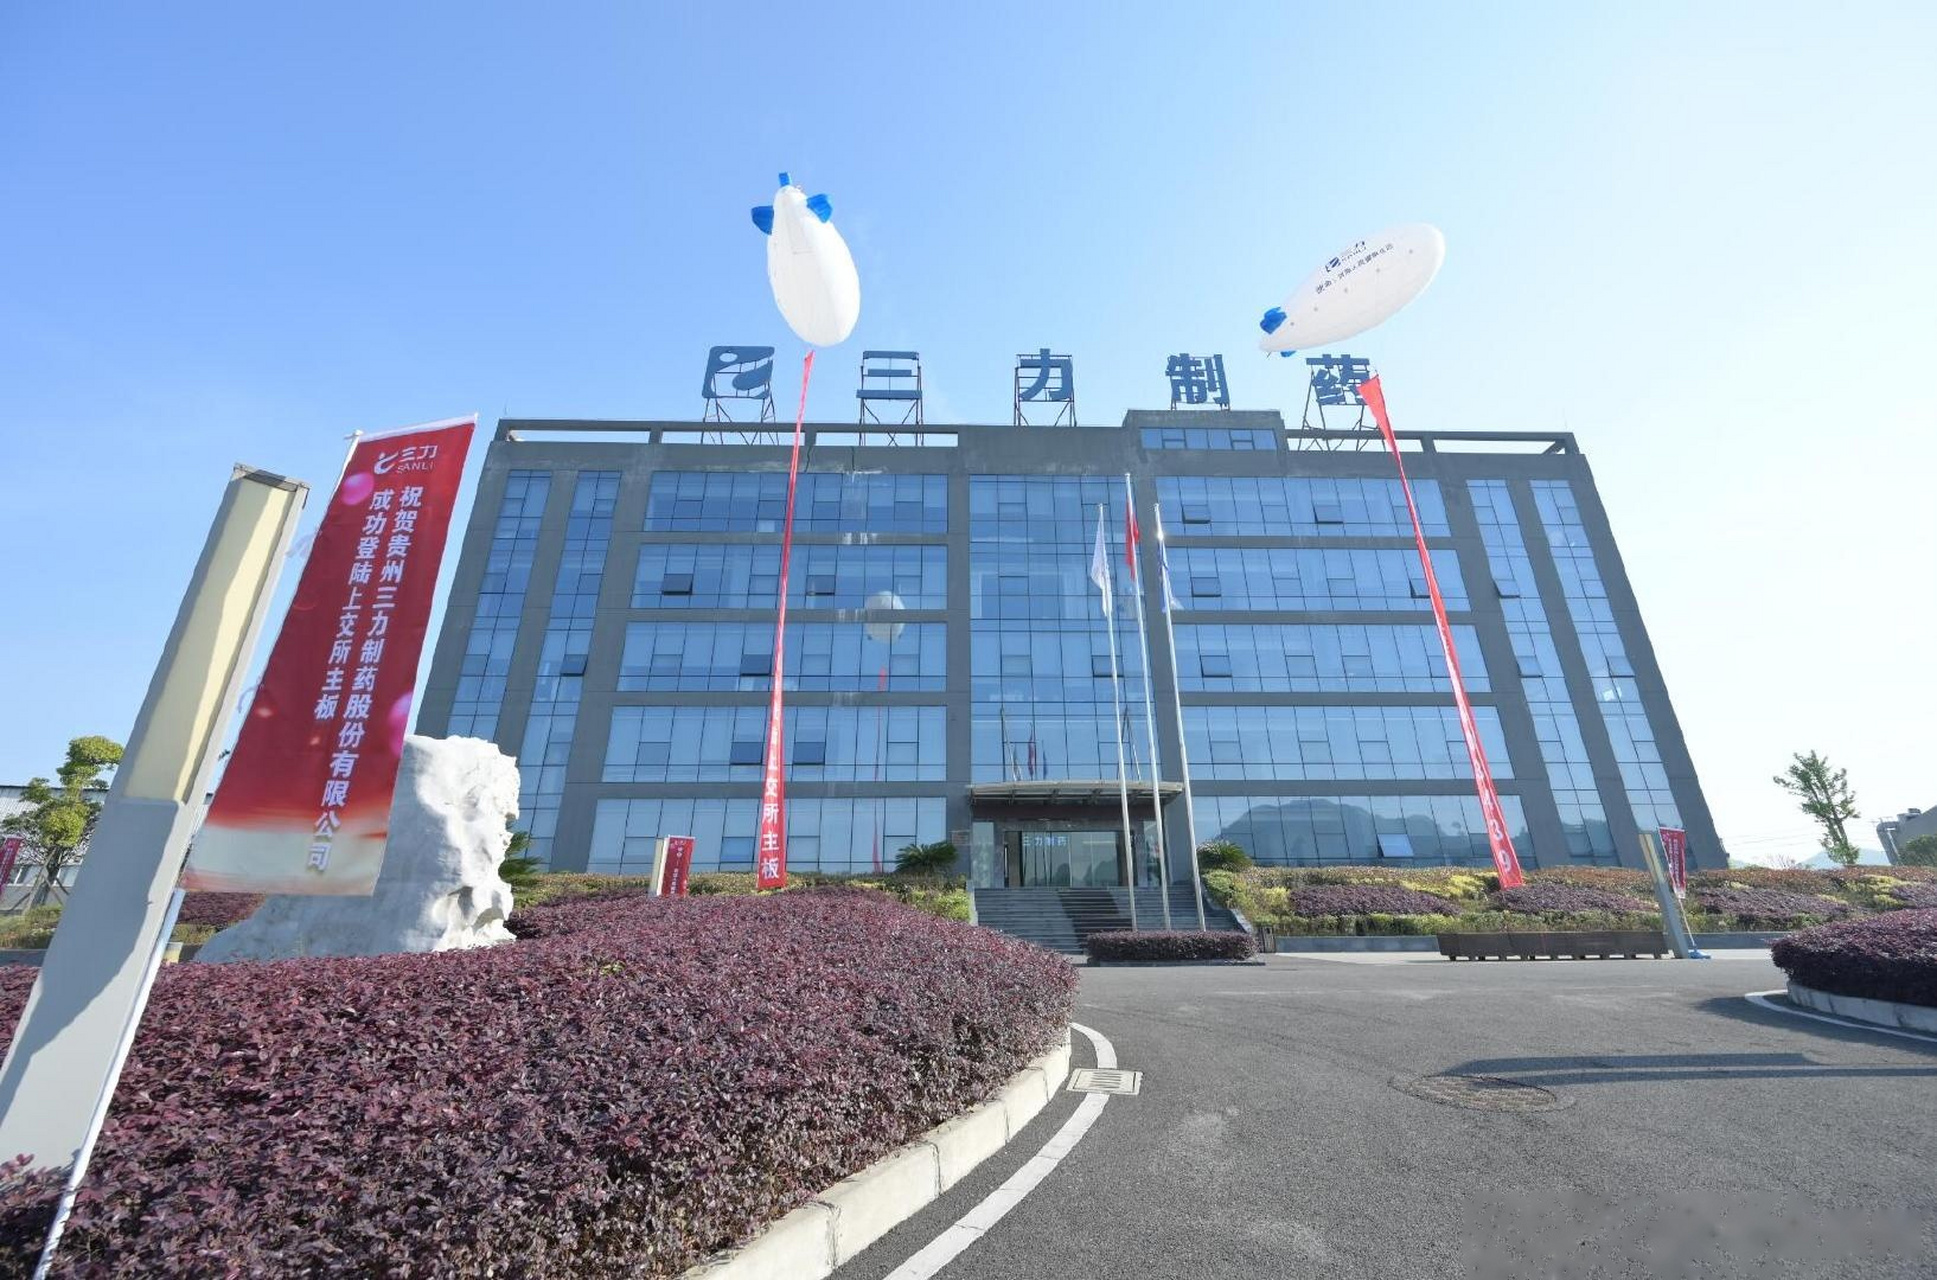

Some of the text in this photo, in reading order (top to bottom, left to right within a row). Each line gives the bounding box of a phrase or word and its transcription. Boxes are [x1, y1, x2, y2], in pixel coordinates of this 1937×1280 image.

[856, 348, 1370, 406] 三力制药
[396, 461, 434, 474] SANLI
[399, 445, 438, 463] 三力
[314, 488, 393, 721] 成功登陆上交所主板
[307, 485, 421, 872] 祝贺贵州三力制药股份有限公司
